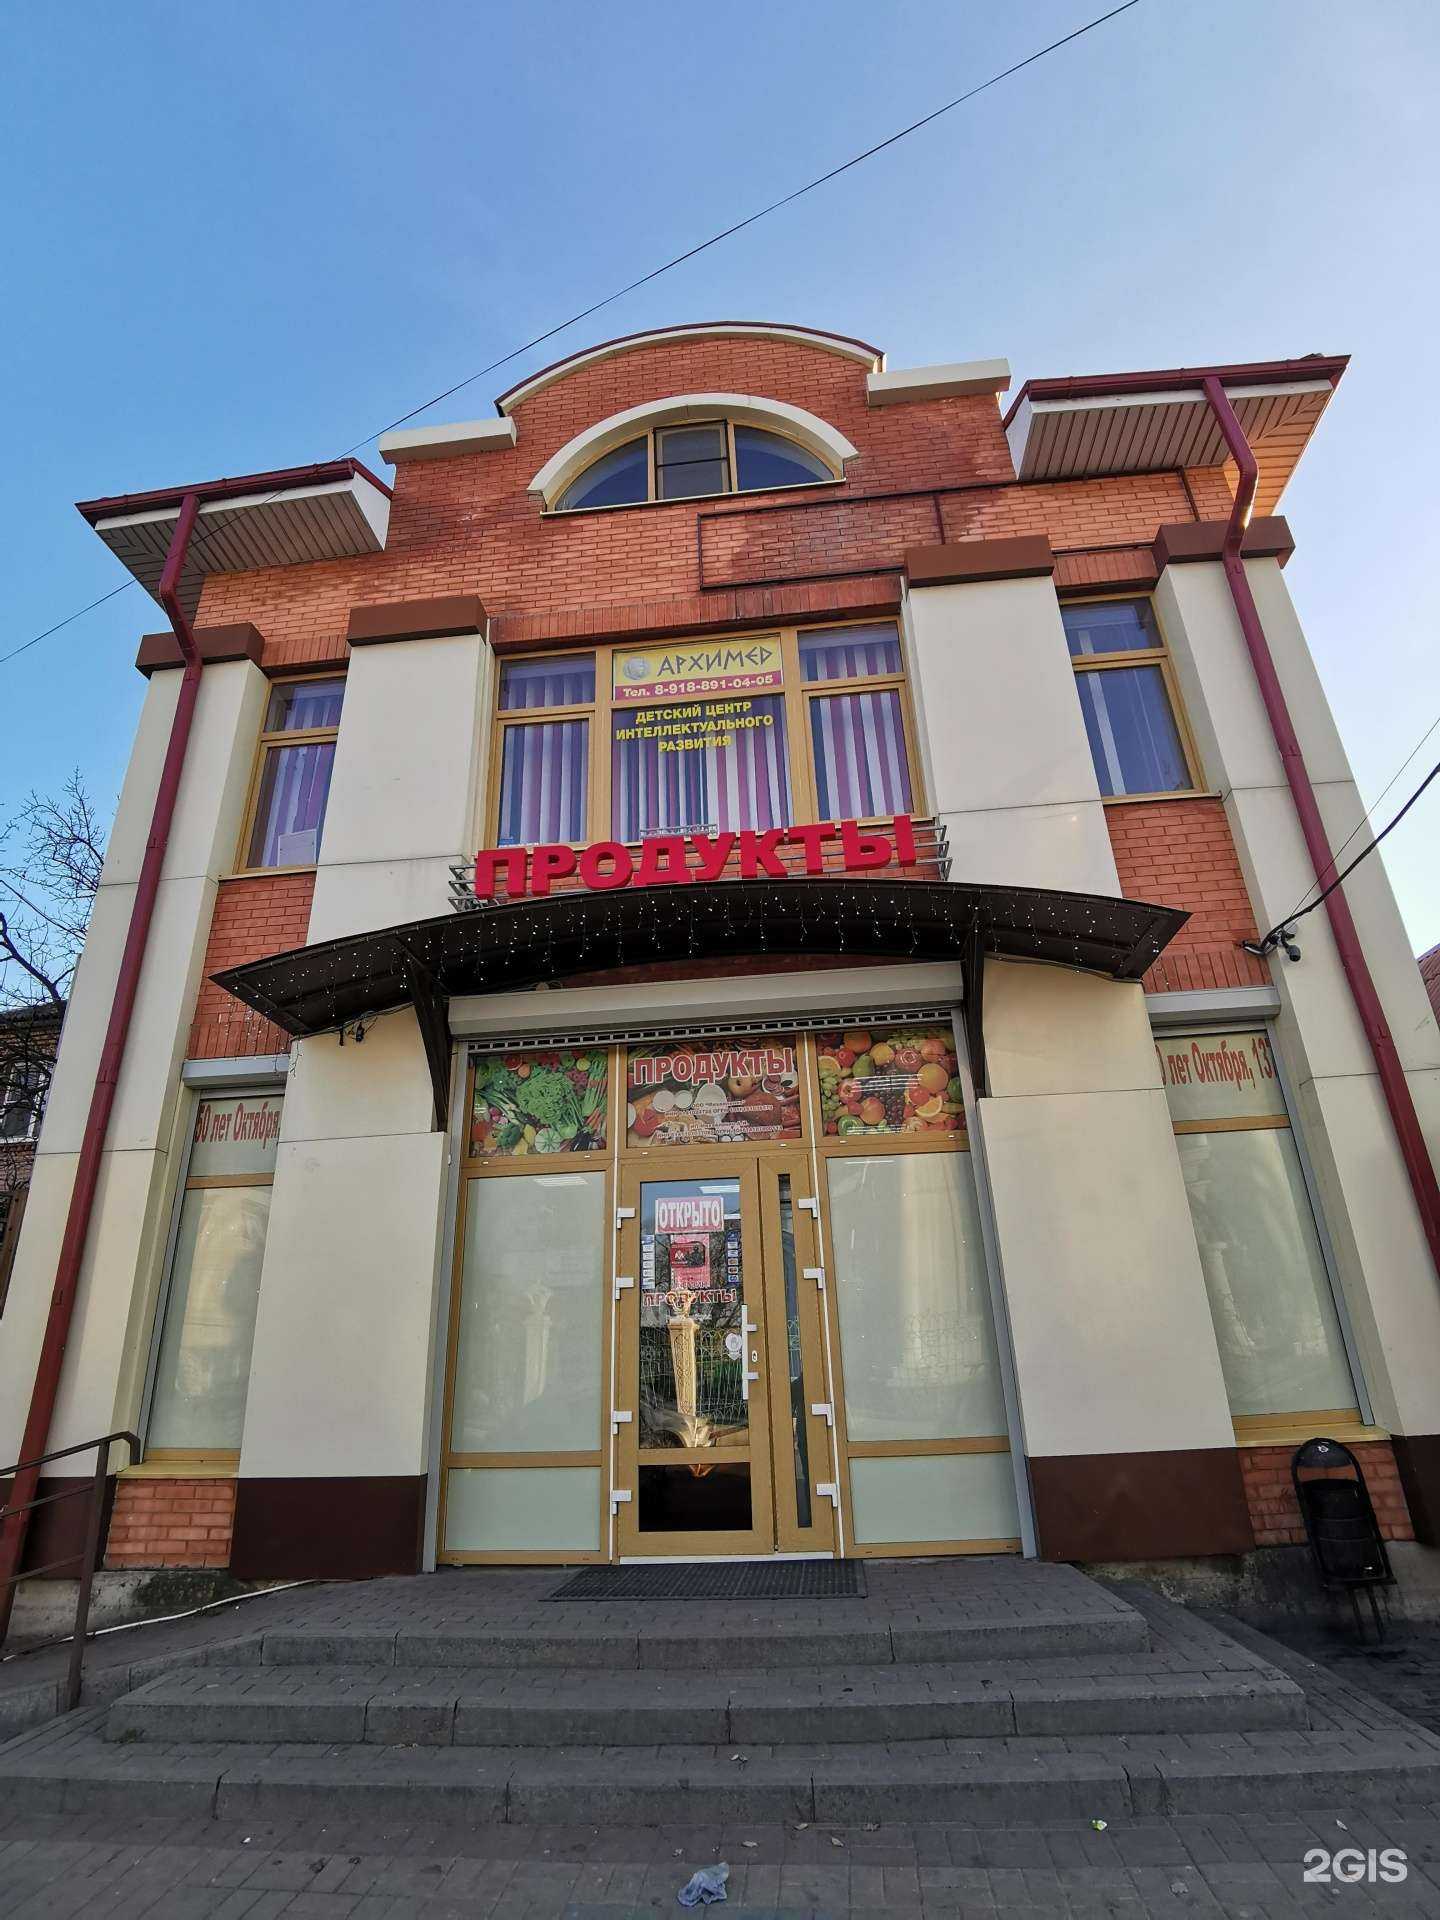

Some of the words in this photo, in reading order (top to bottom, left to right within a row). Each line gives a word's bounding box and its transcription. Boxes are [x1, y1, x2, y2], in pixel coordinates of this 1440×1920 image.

[657, 646, 772, 676] АРХИМЕД
[655, 675, 773, 694] 8-918-891-04-05
[636, 705, 701, 724] ДЕТСКИЙ
[706, 702, 751, 716] ЦЕНТР
[616, 715, 773, 740] ИНТЕЛЛЕКТУАЛЬНОГО
[658, 735, 731, 752] РАЗВИТИЯ
[474, 815, 916, 899] ПРОДУКТЫ
[634, 1048, 793, 1085] ПРОДУКТЫ
[659, 1200, 721, 1228] ОТКРЫТО
